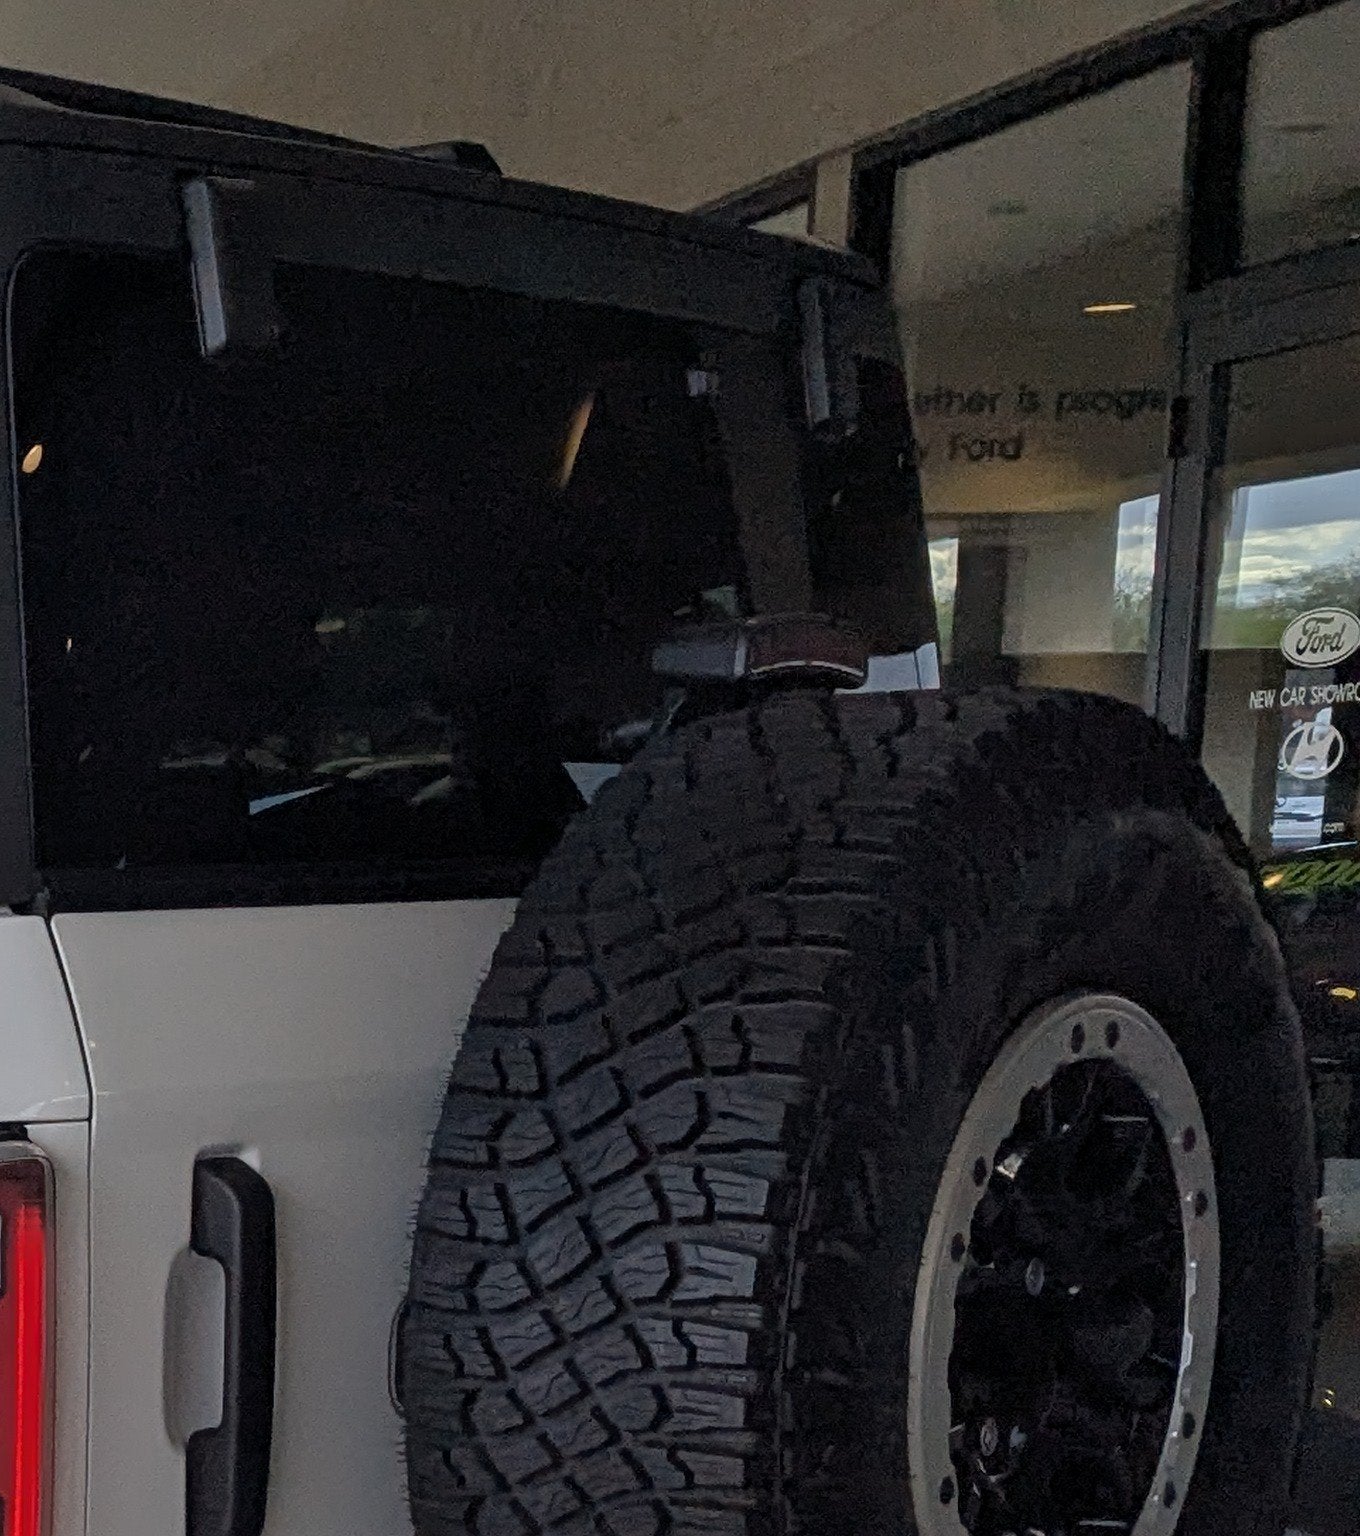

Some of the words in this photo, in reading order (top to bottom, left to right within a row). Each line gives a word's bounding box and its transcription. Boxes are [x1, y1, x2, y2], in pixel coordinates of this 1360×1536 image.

[1295, 616, 1346, 656] Ford
[1248, 689, 1277, 709] NEW
[1280, 686, 1307, 707] CAR
